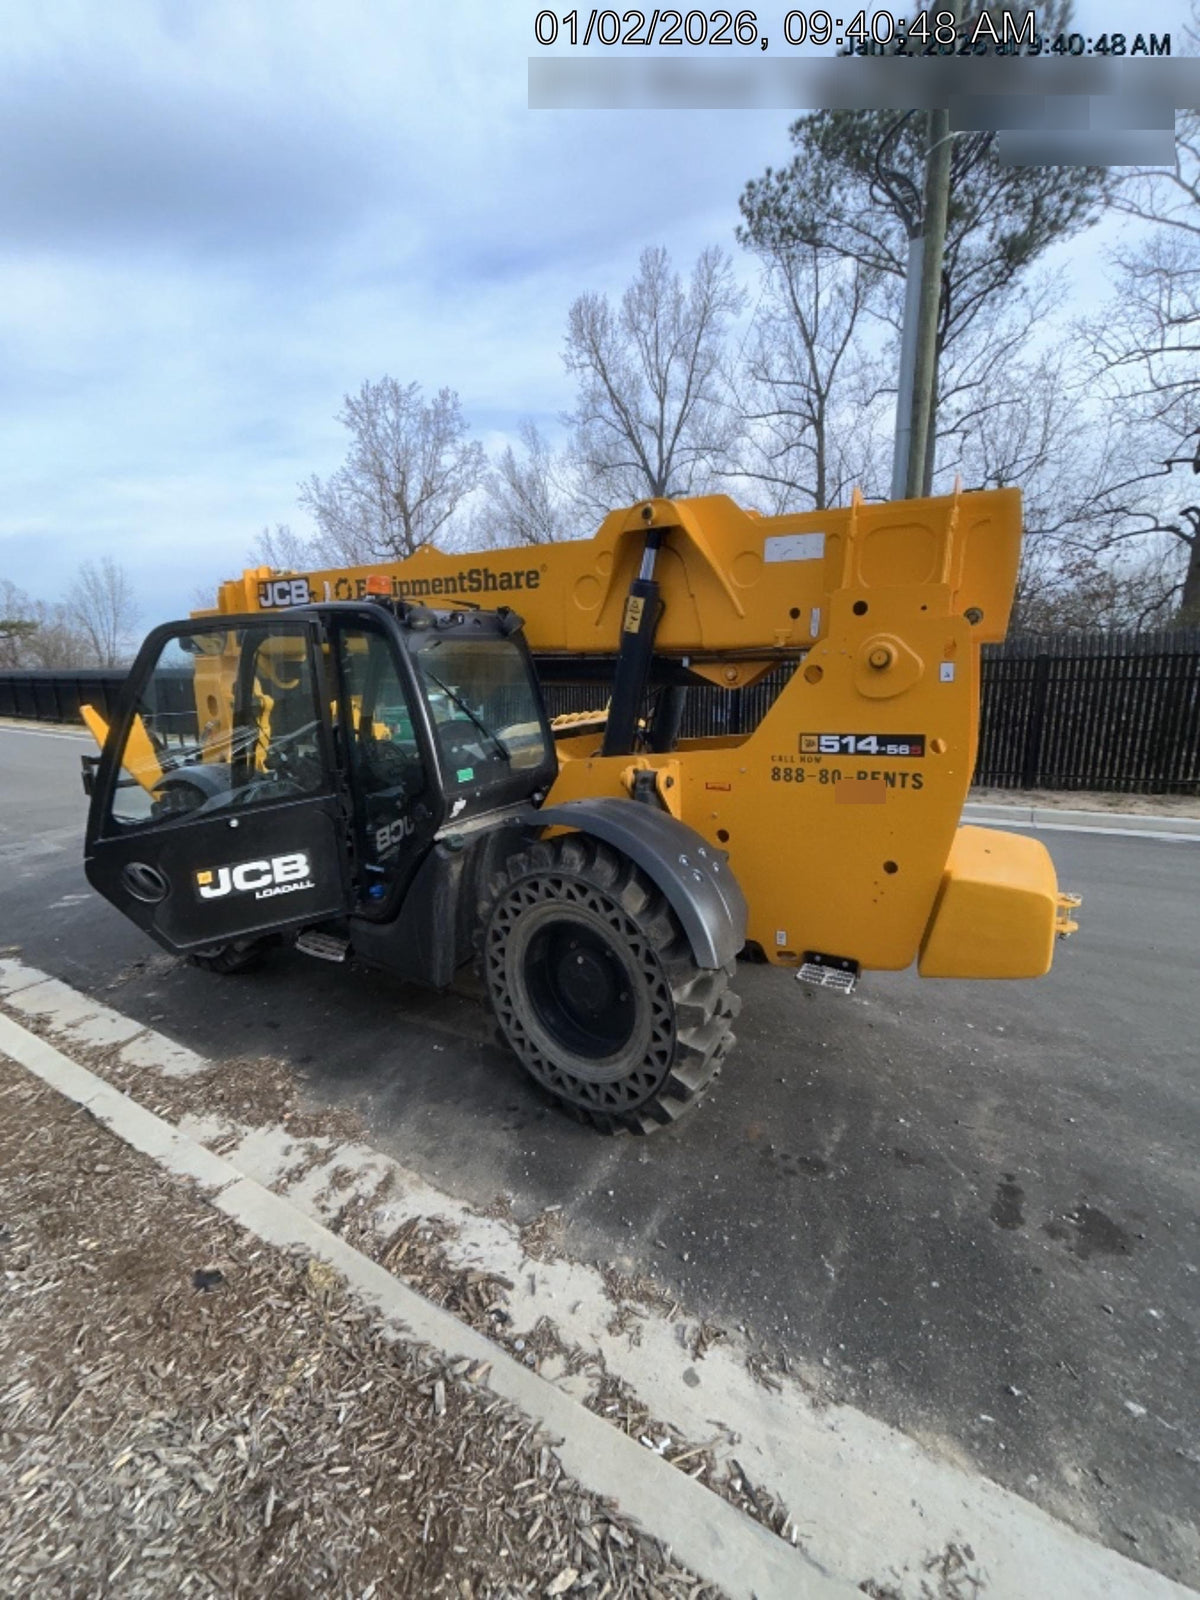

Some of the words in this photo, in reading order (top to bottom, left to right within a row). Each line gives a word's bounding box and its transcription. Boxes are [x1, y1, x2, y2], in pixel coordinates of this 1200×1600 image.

[259, 579, 310, 607] JCB
[771, 755, 796, 763] CALL
[800, 755, 822, 764] NOW
[198, 853, 310, 898] JCB
[255, 880, 316, 900] LOADALL
